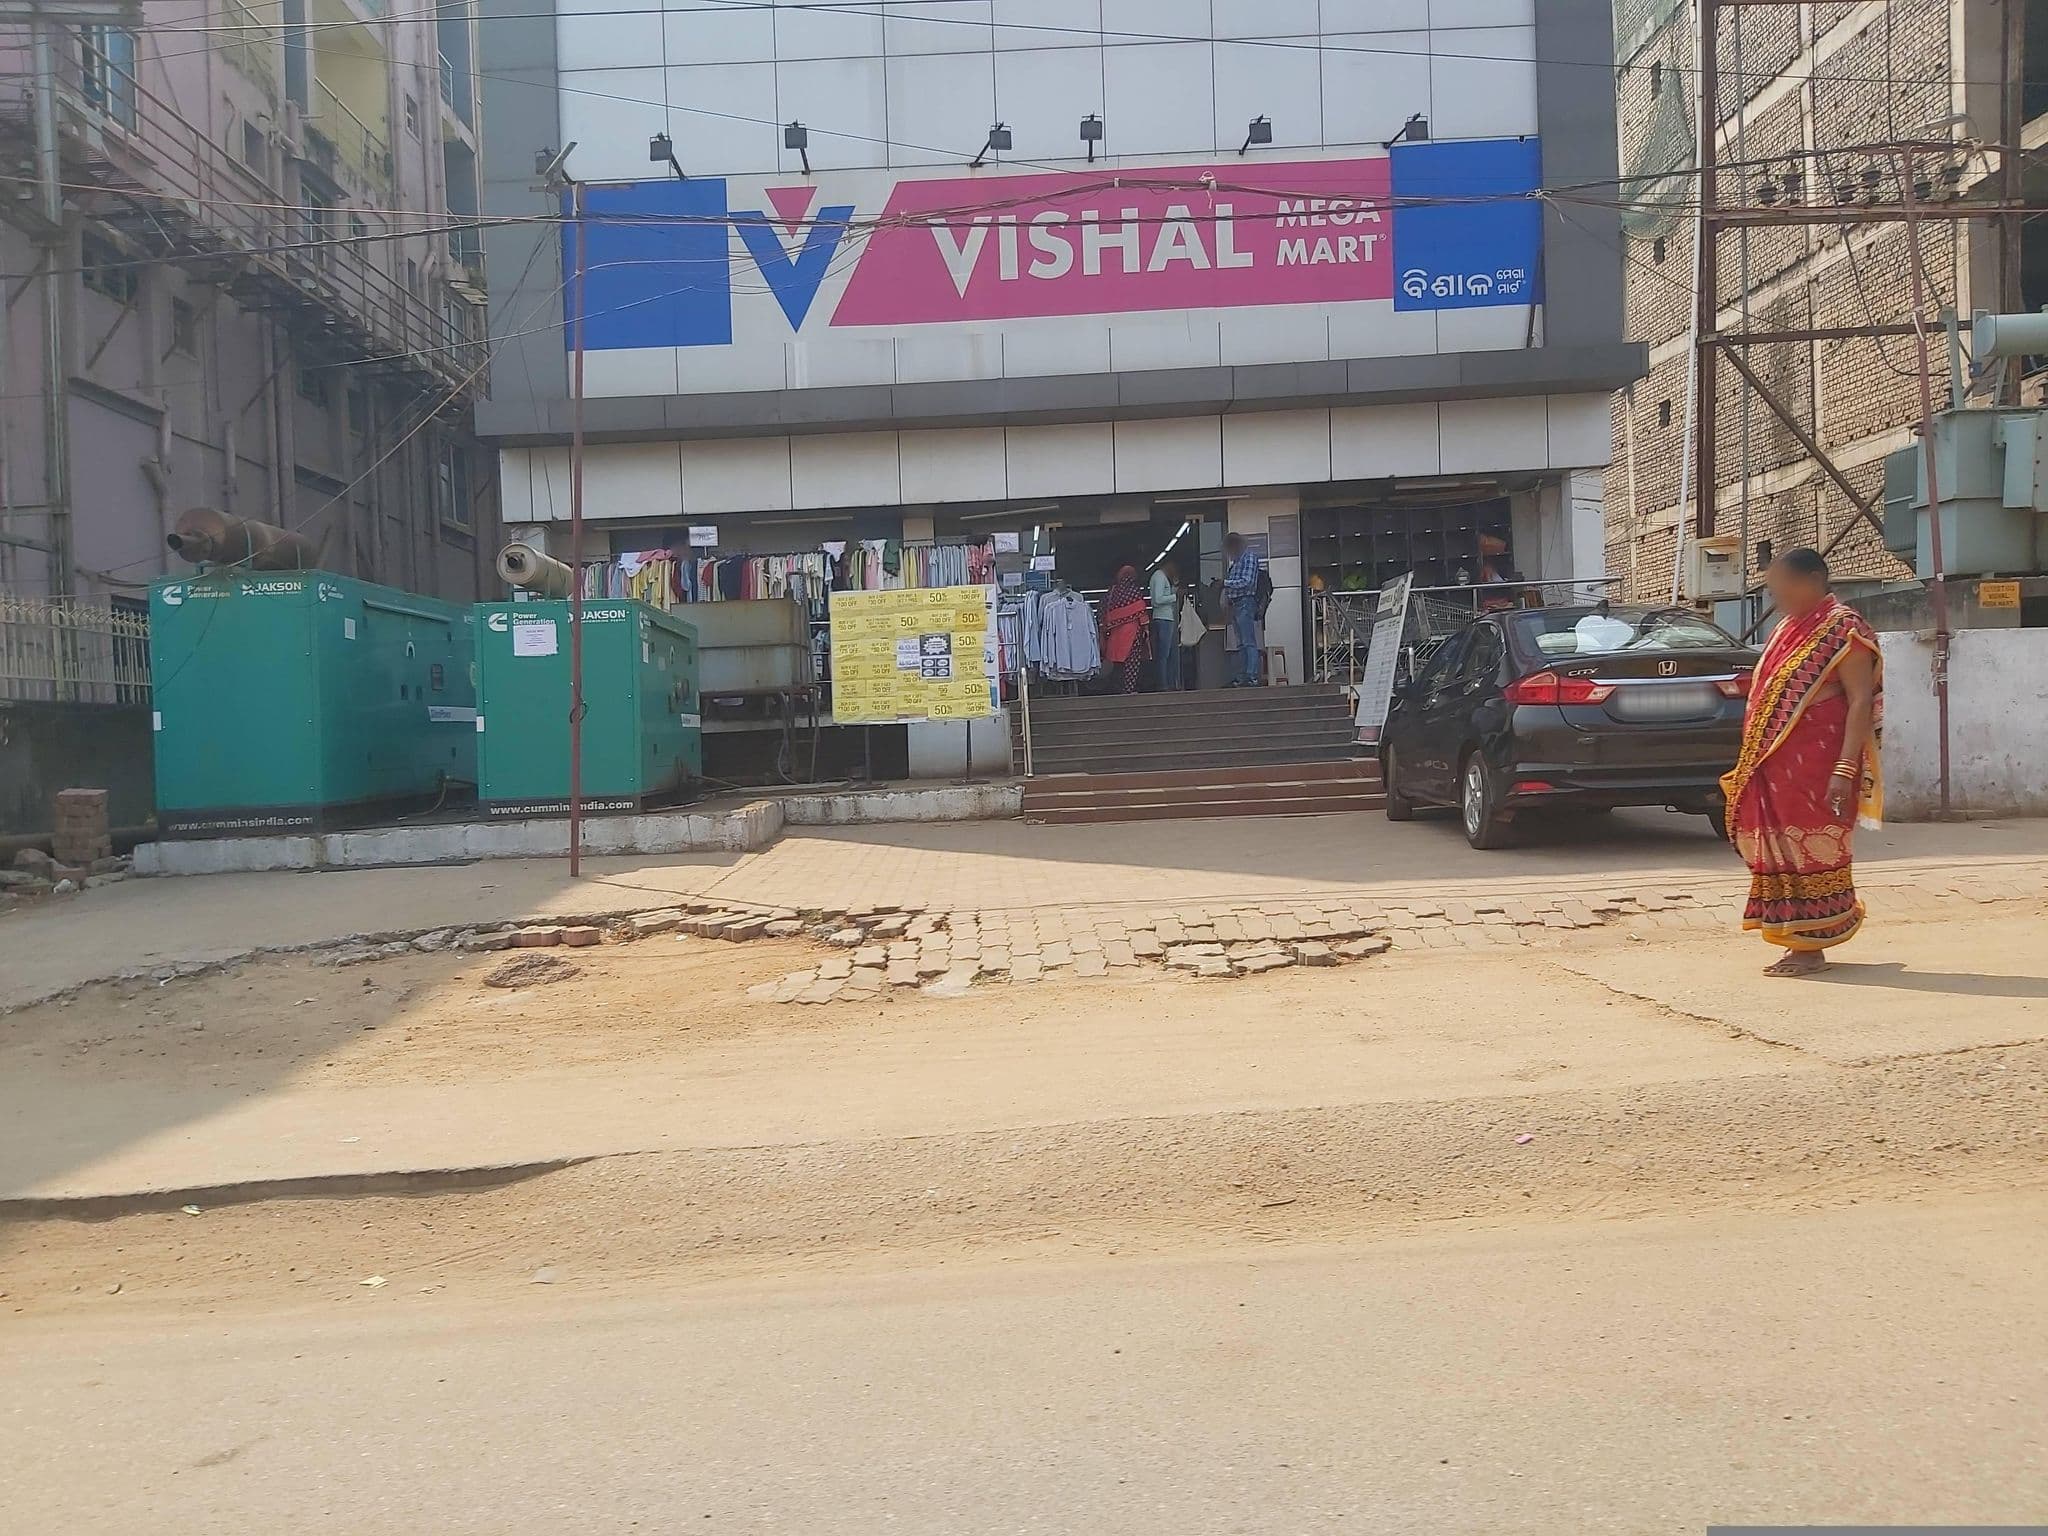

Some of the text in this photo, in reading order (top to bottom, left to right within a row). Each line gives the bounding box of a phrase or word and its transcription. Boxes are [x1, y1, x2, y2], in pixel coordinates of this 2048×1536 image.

[1275, 200, 1382, 228] MEGA
[926, 203, 1254, 301] VISHAL
[1276, 234, 1378, 266] MART
[1496, 268, 1525, 280] ମେଗା
[1402, 268, 1493, 299] ବିଶାଳ
[254, 582, 302, 592] JAKSON
[580, 610, 626, 620] JAKSON
[1568, 667, 1600, 677] CITY
[490, 800, 634, 815] www.cumminndia.com
